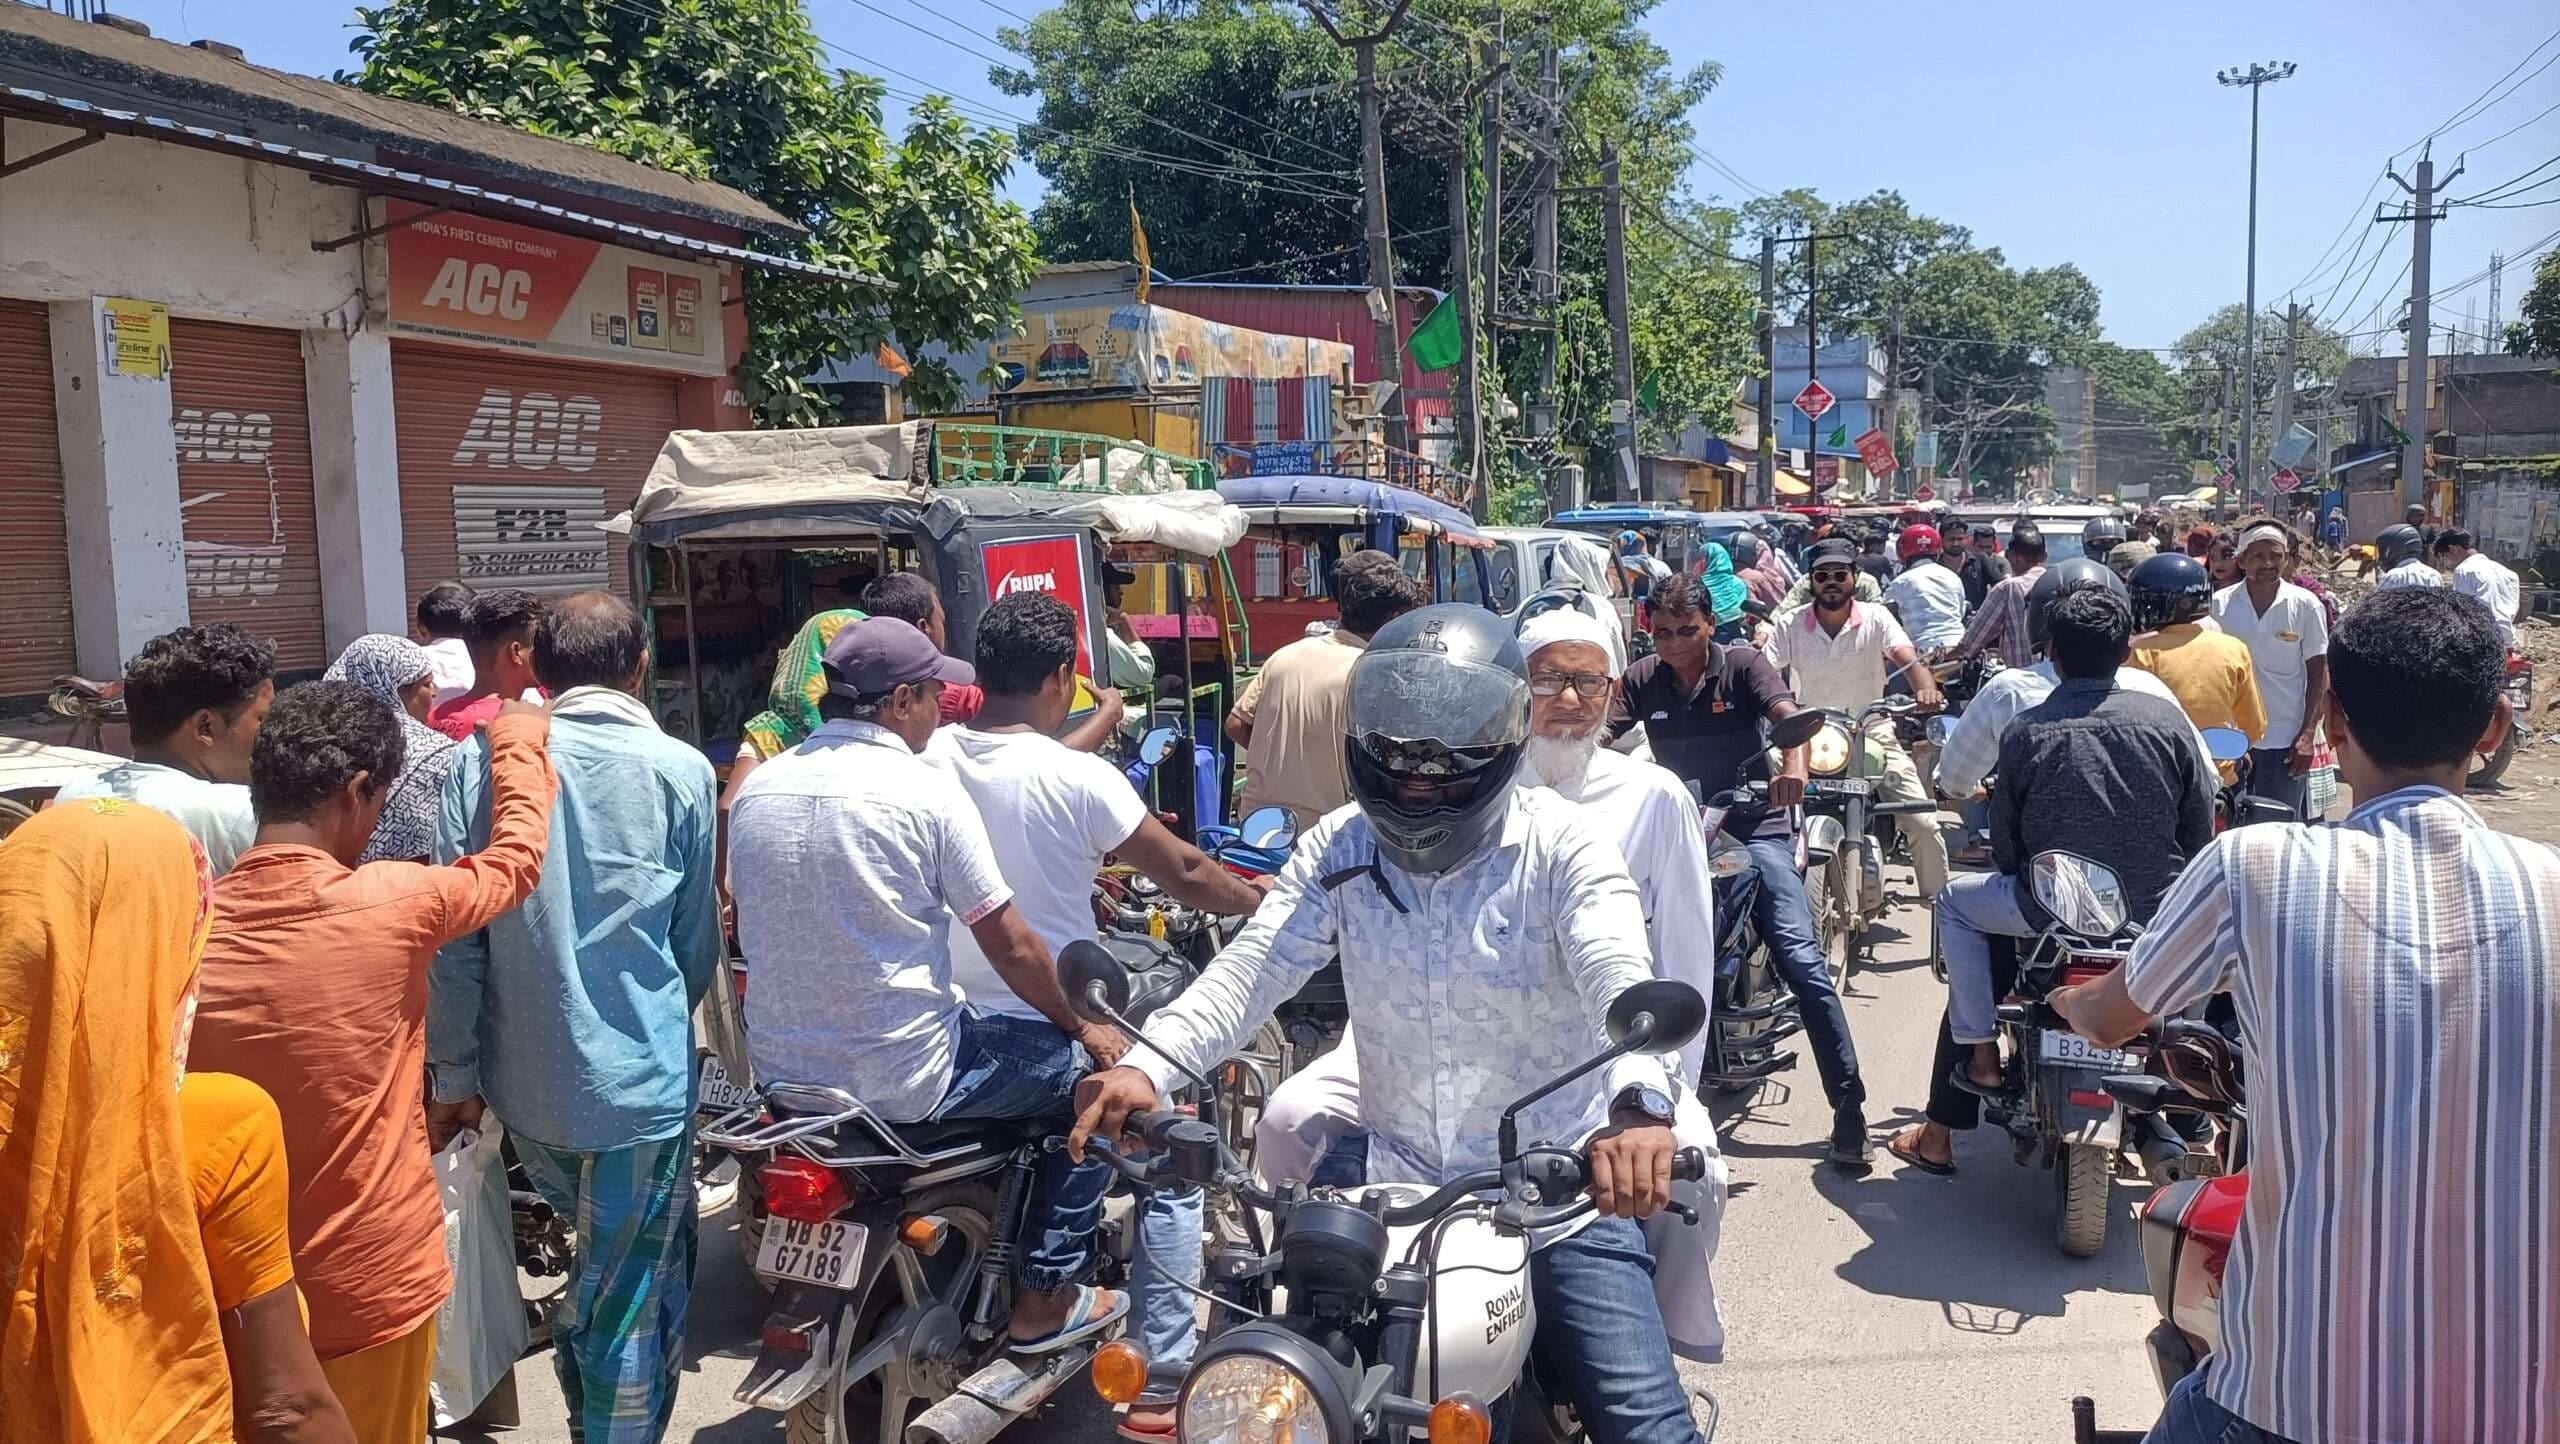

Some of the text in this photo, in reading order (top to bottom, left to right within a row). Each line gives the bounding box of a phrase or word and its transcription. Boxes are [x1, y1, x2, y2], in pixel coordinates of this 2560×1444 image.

[449, 226, 475, 242] FIRST
[476, 232, 514, 251] CEMENT
[514, 241, 558, 260] COMPANY
[422, 257, 532, 321] ACC
[1056, 327, 1079, 337] STAR
[175, 409, 272, 463] ACC
[452, 388, 602, 472] ACC
[494, 509, 570, 541] F2R
[486, 551, 603, 576] SUPERFAST
[1010, 572, 1056, 594] RUPA
[1650, 710, 1669, 720] KTM
[785, 1219, 847, 1252] WB 92
[775, 1245, 842, 1283] G7189
[1485, 1284, 1522, 1321] ROYAL
[1486, 1300, 1527, 1345] ENFIELD
